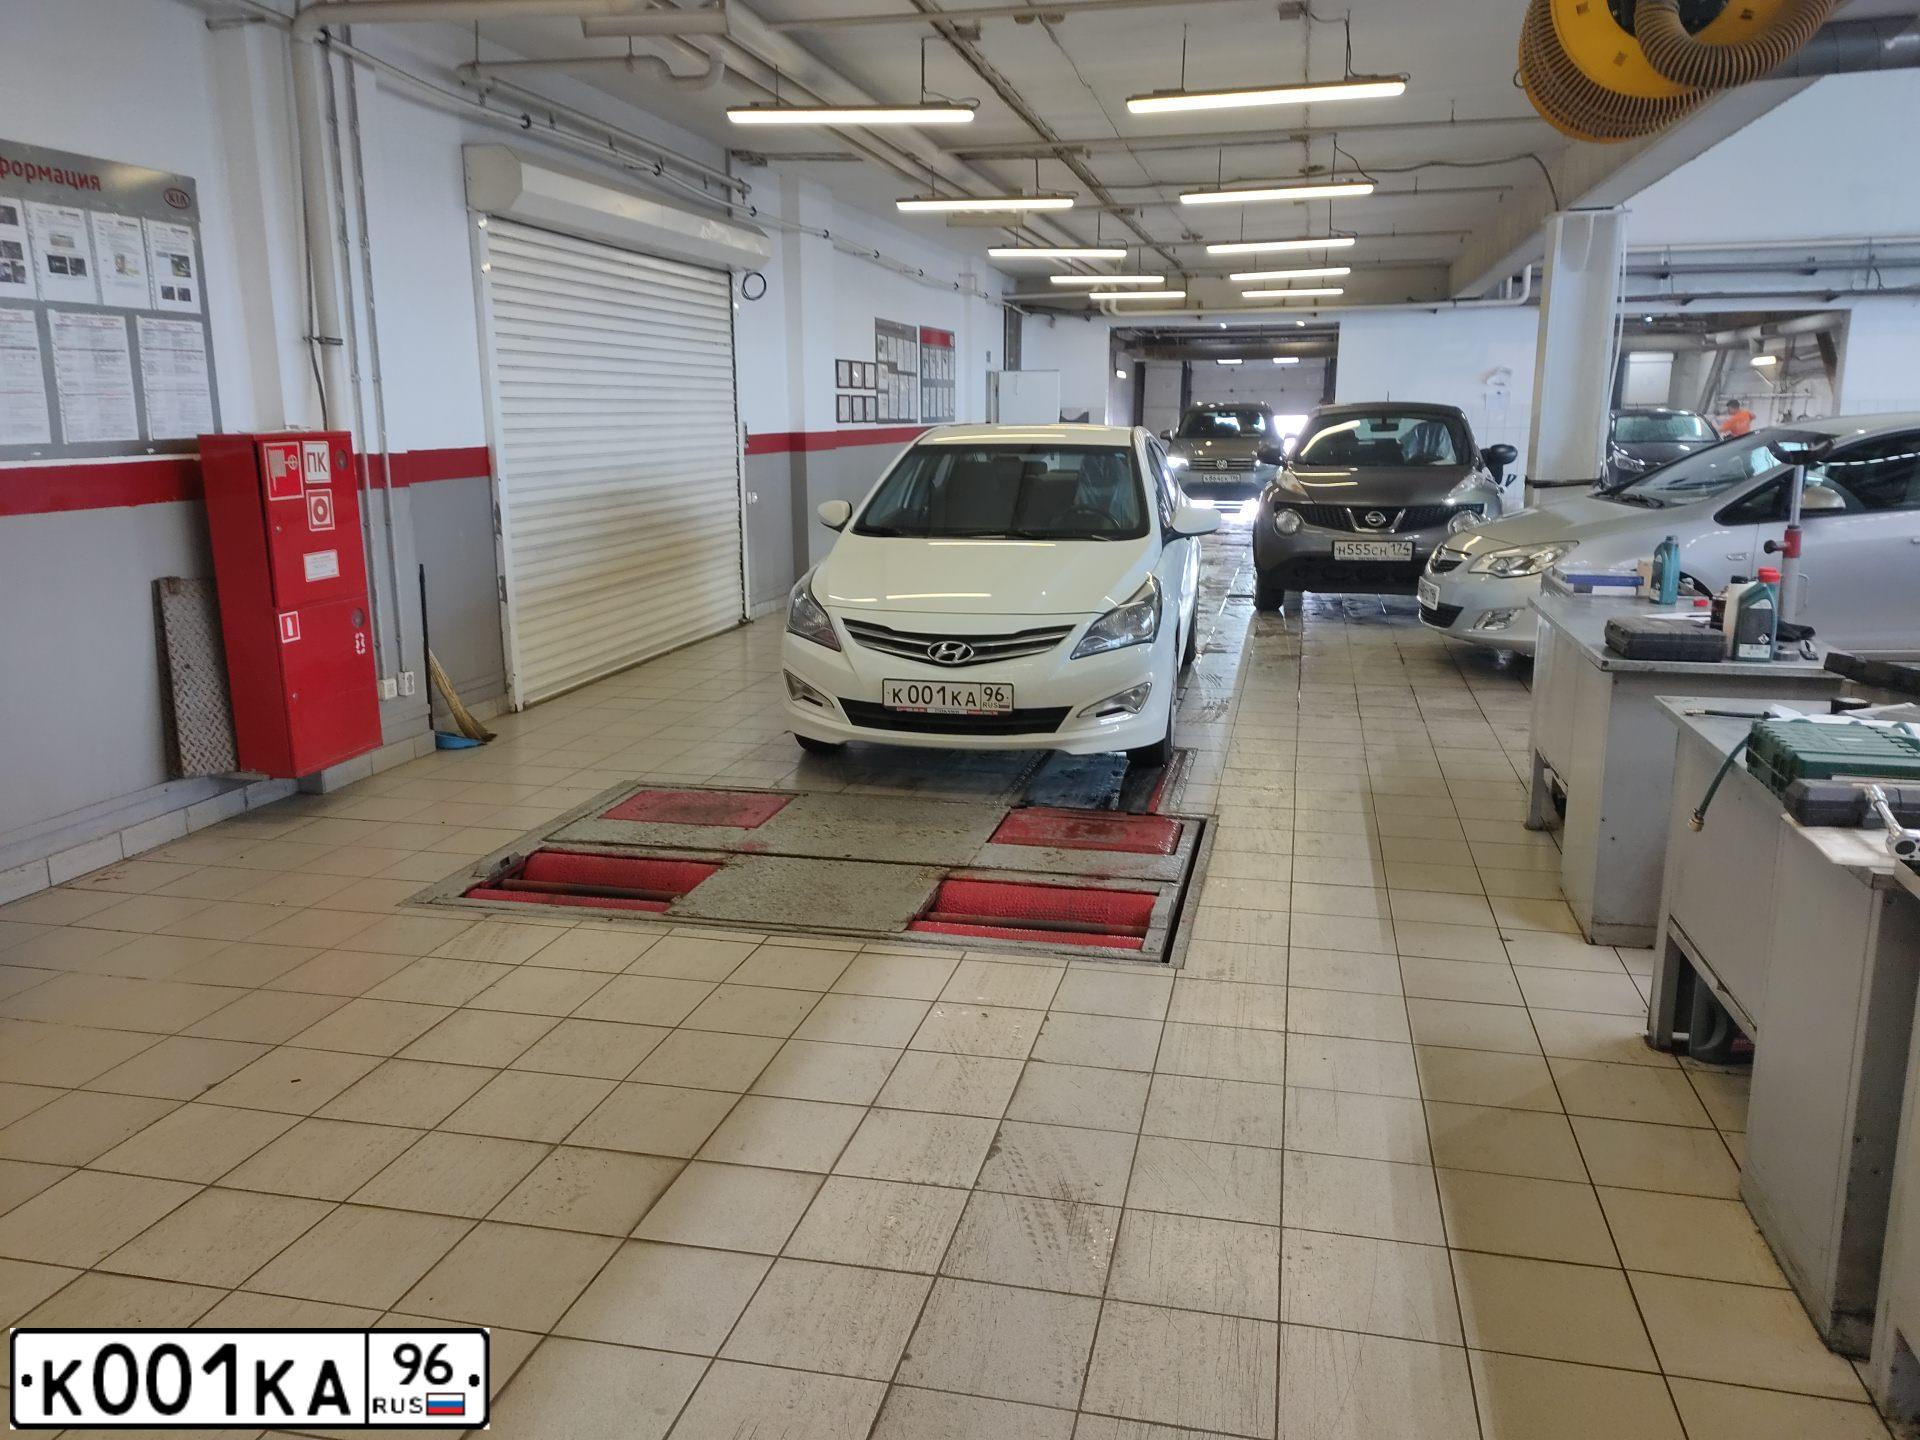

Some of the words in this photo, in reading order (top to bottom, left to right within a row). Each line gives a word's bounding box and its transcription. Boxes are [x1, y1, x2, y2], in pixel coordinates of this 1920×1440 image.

[306, 452, 328, 472] ПК
[892, 684, 977, 707] К001КА
[983, 687, 1004, 702] 96
